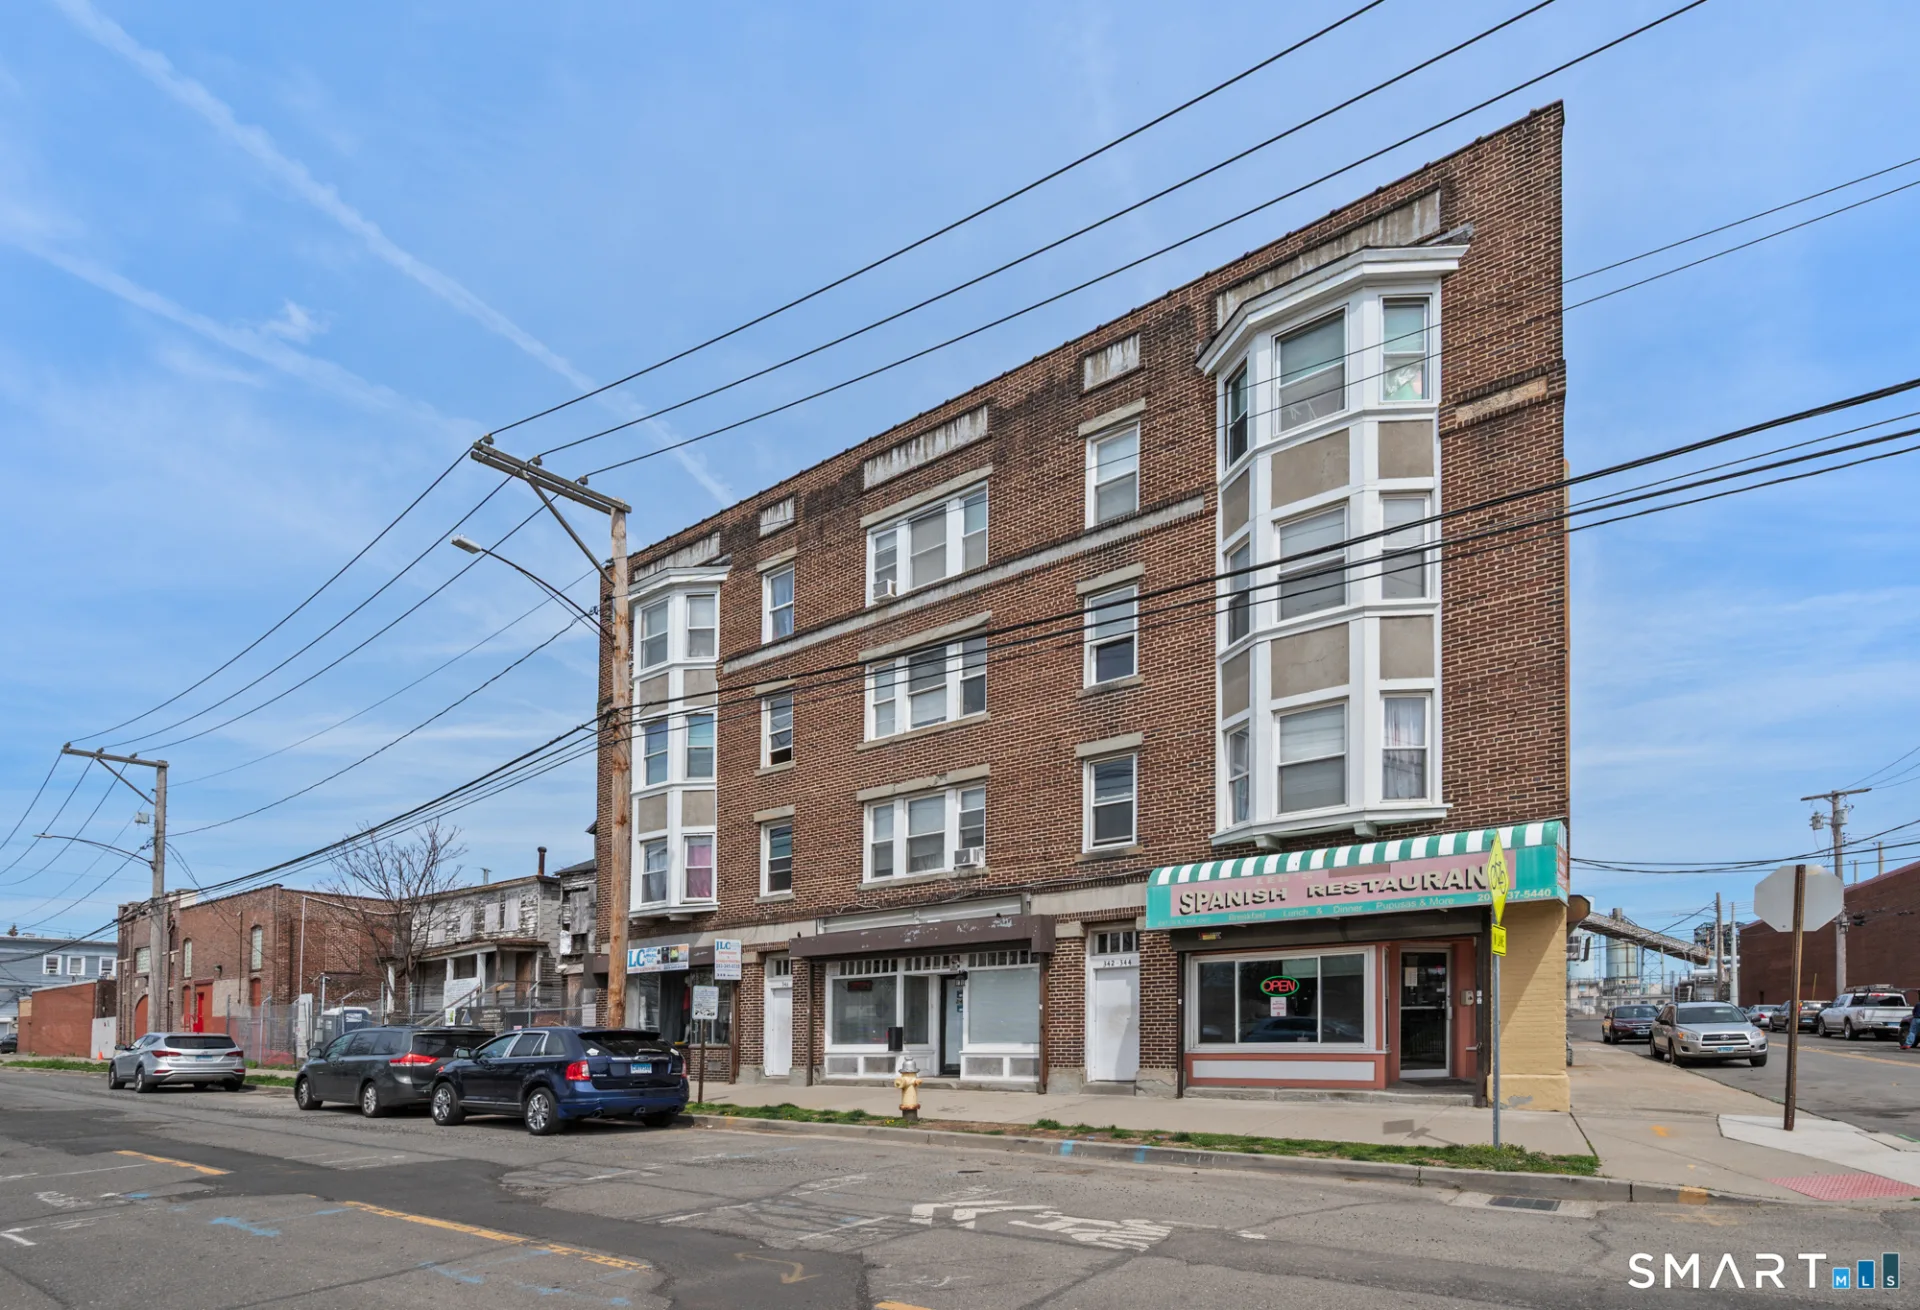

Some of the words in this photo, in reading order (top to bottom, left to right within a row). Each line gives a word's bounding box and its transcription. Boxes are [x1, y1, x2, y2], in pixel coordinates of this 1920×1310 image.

[1180, 888, 1288, 915] SPANISH
[1307, 859, 1508, 898] RESTAURAN
[1477, 888, 1552, 902] 2037-5440
[1228, 911, 1266, 921] Breakfast
[1283, 908, 1309, 917] Lunch
[1316, 907, 1323, 915] &
[1333, 905, 1363, 914] Dinner
[1376, 897, 1417, 910] Pupusas
[1420, 898, 1427, 907] &
[1429, 896, 1455, 905] More
[716, 941, 731, 951] JLC
[628, 949, 645, 967] LC
[1262, 980, 1296, 992] OPEN
